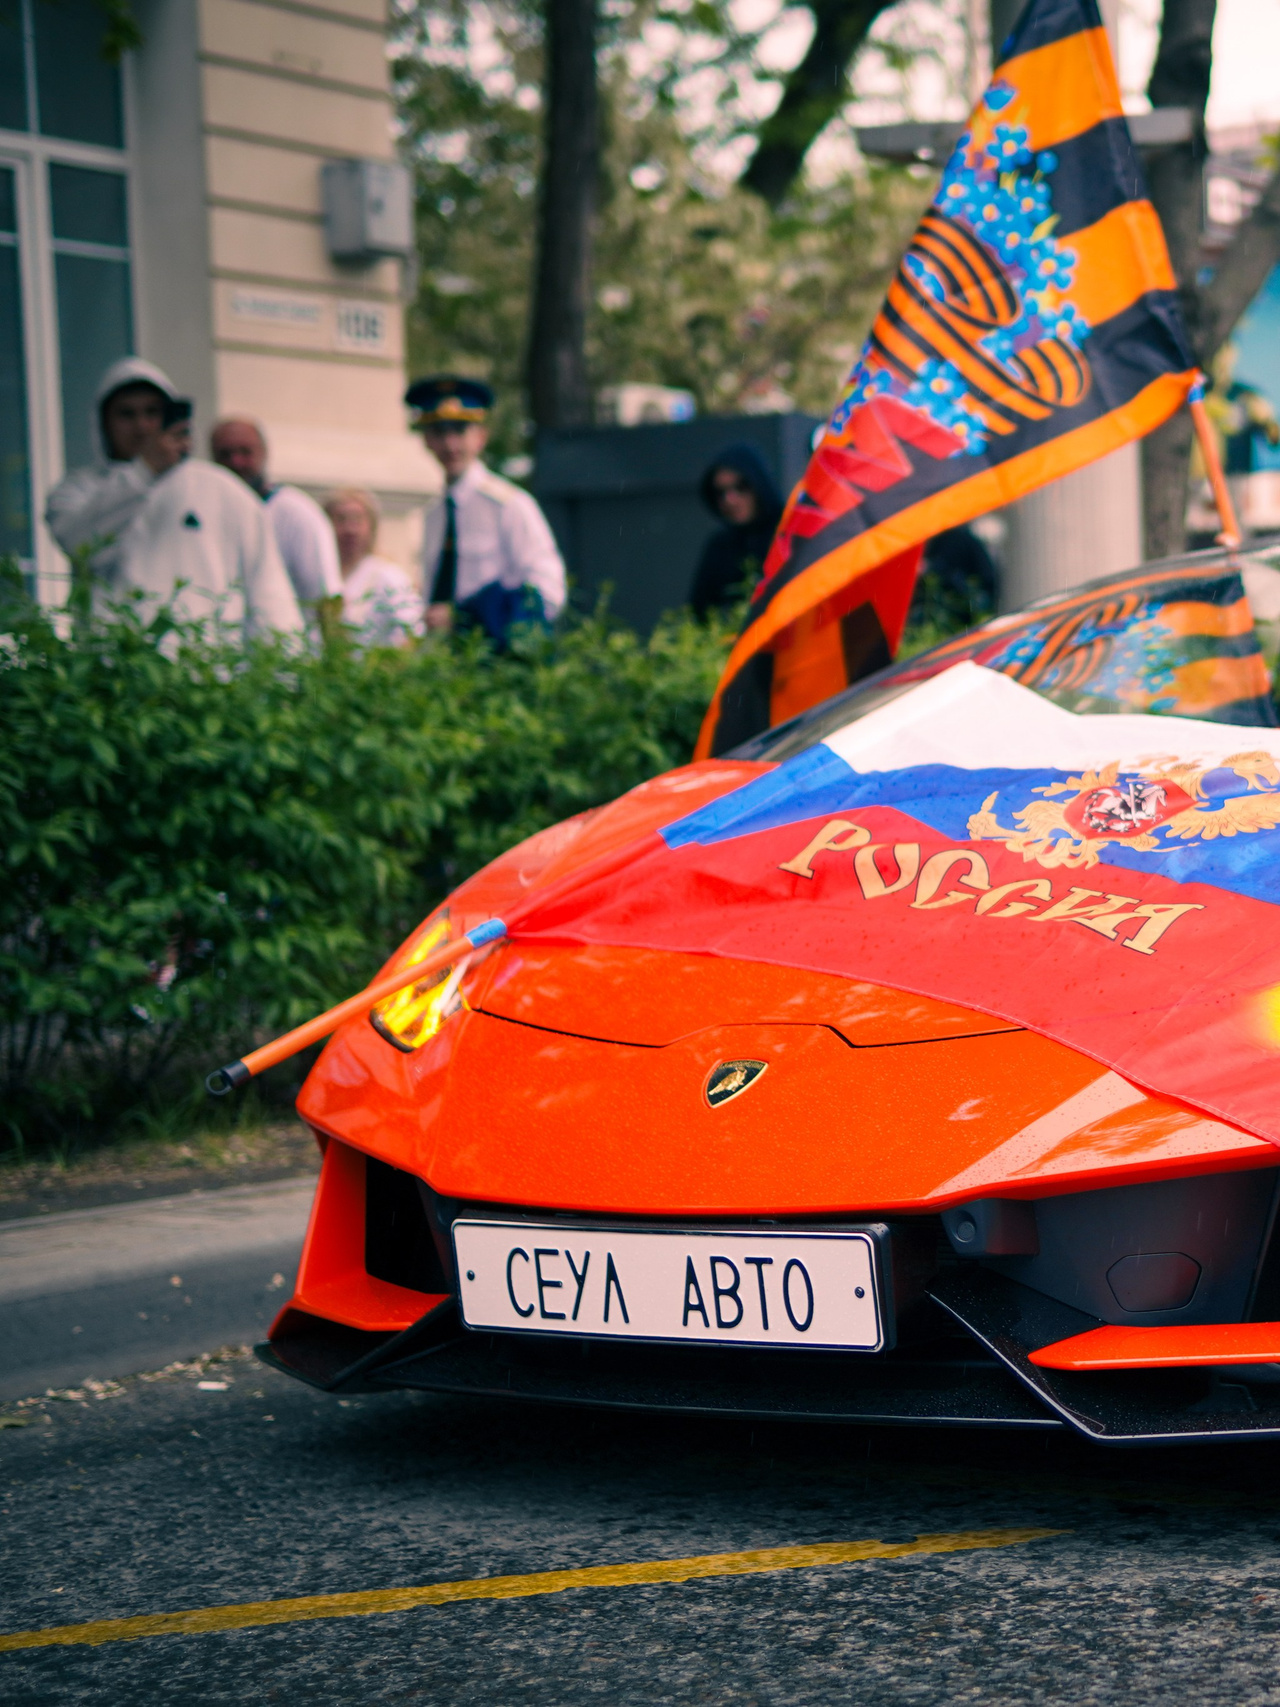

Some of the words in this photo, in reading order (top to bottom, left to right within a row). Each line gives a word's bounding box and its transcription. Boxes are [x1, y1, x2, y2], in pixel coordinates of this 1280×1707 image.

[778, 819, 1206, 955] РОССИЯ
[506, 1247, 630, 1325] СЕУЛ
[682, 1254, 815, 1333] АВТО
